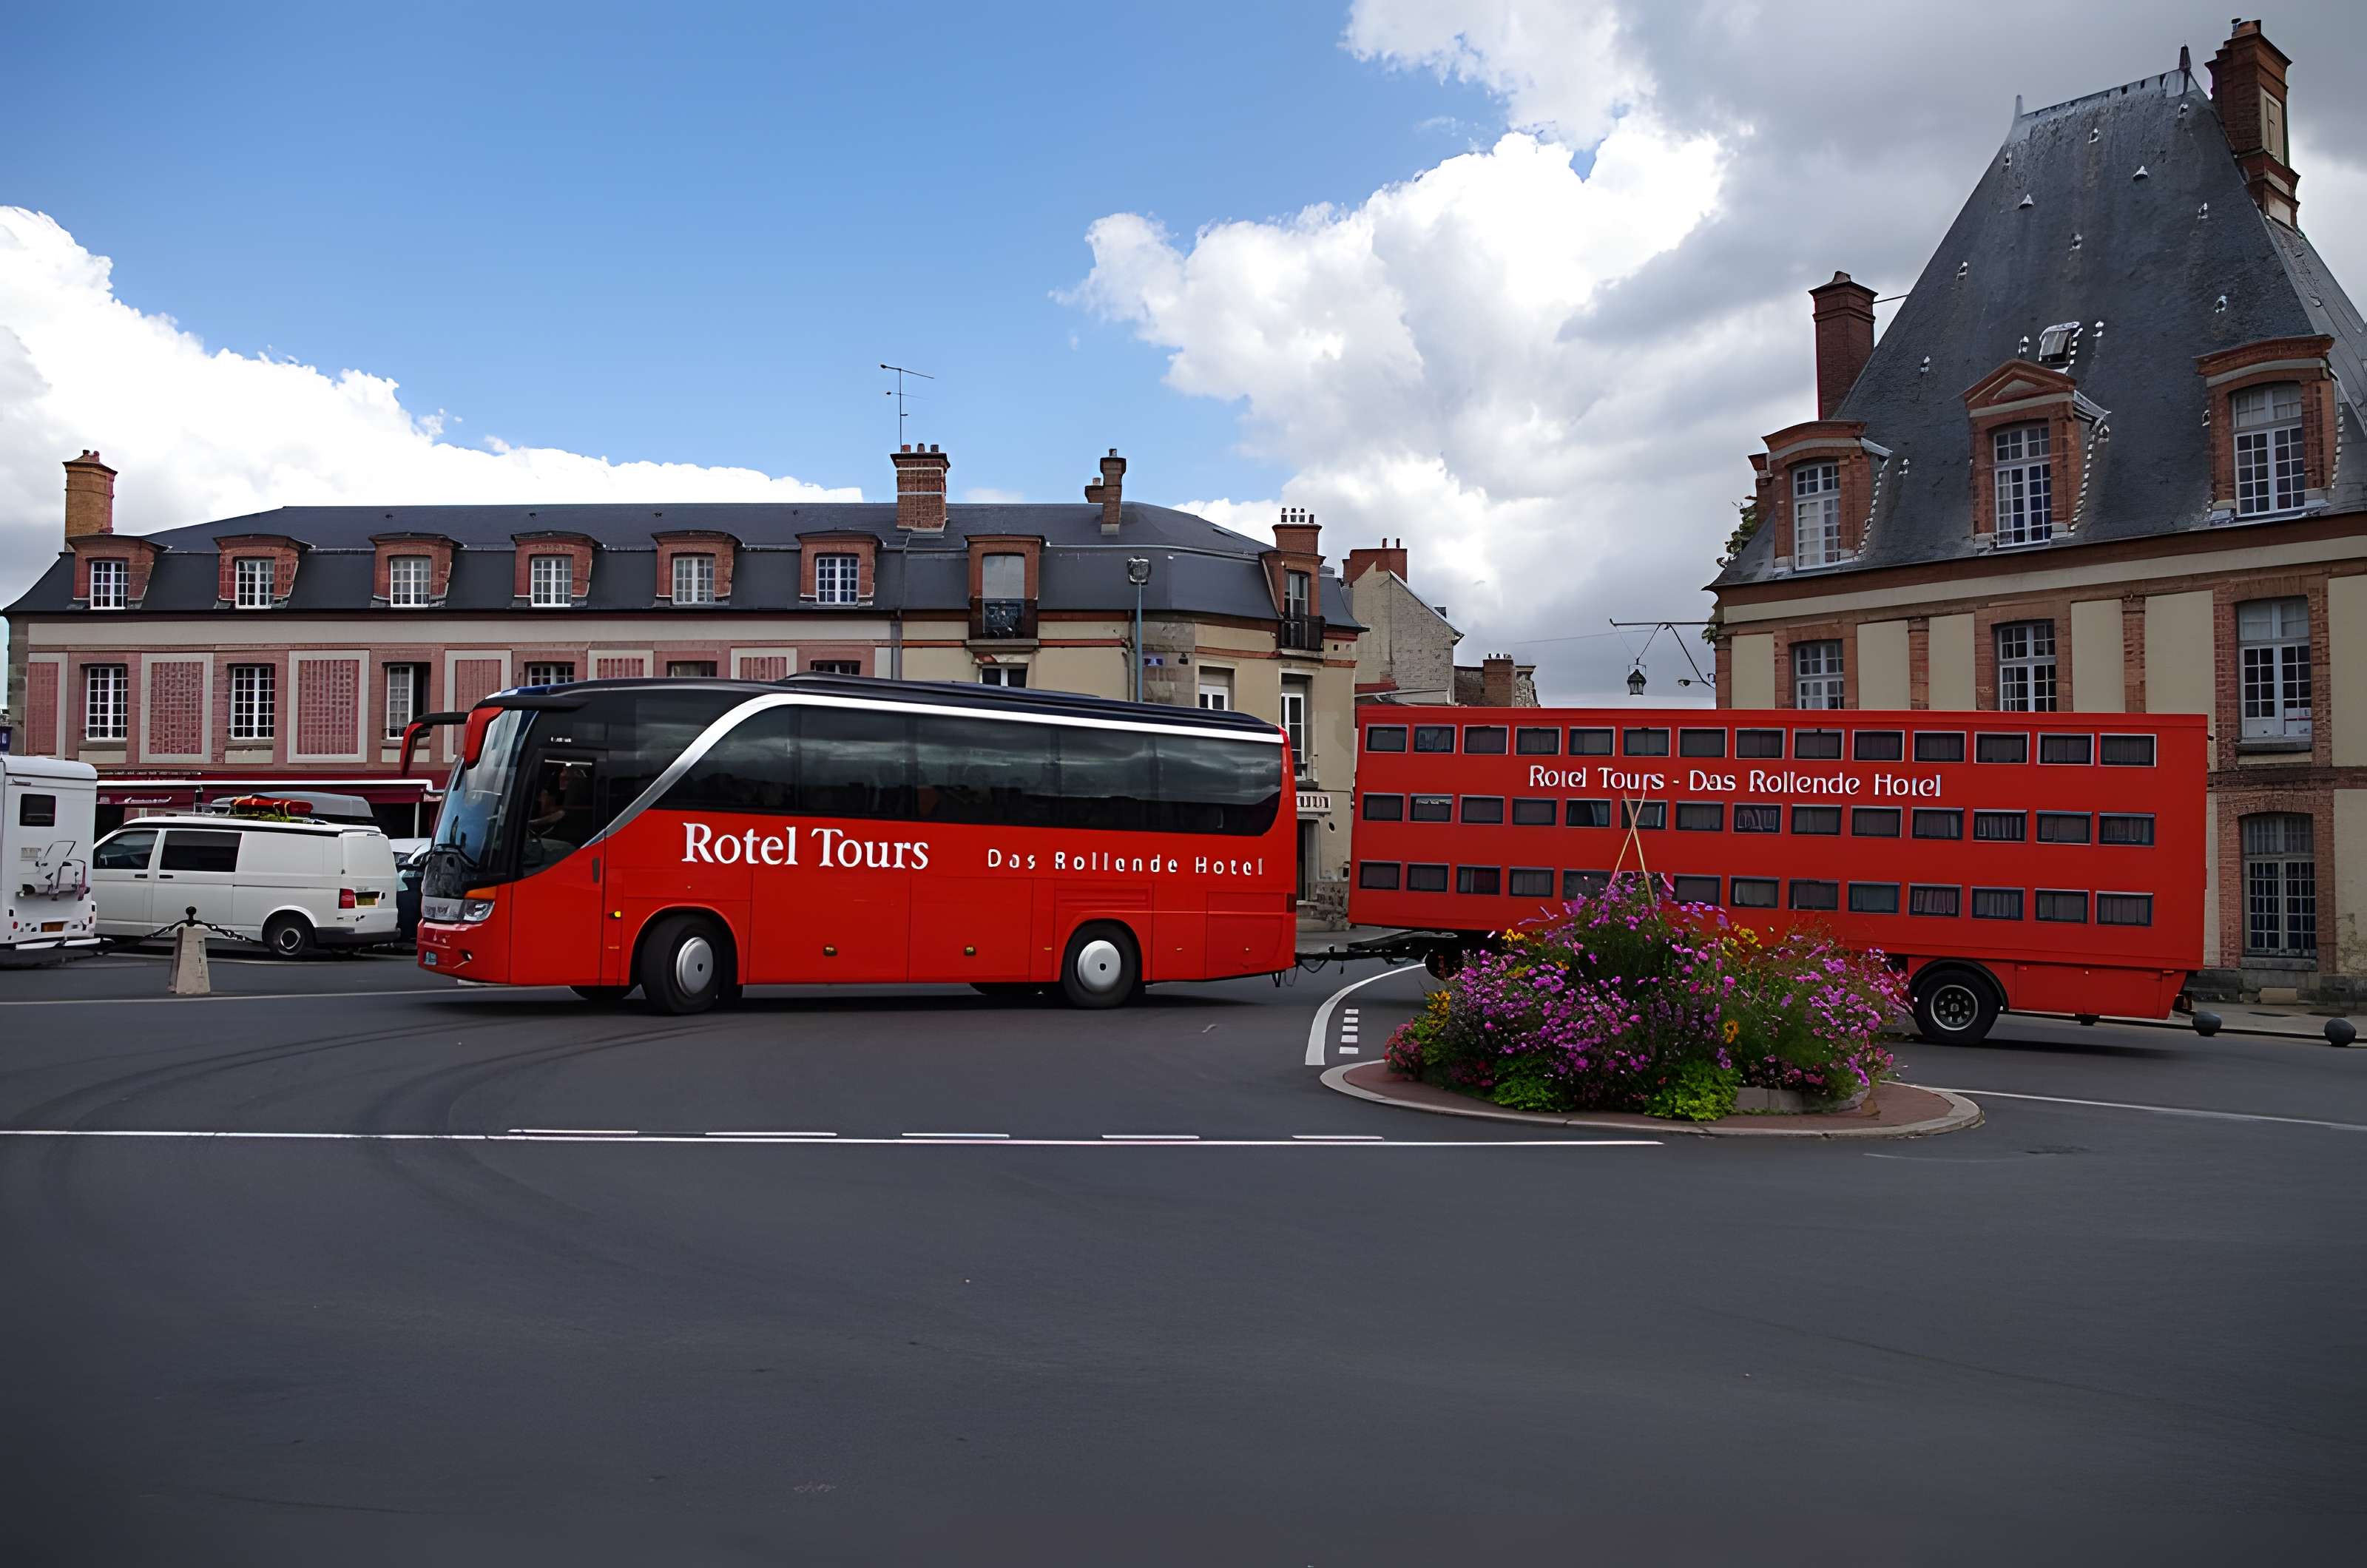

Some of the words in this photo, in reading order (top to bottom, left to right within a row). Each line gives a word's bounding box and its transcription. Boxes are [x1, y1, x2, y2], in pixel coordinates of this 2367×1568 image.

[1529, 765, 1587, 788] Rotel
[1597, 767, 1664, 791] Tours
[1689, 769, 1736, 791] Das
[1749, 769, 1860, 795] Rollende
[1874, 773, 1941, 797] Hotel
[681, 822, 799, 865] Rotel
[811, 828, 929, 870] Tours
[987, 848, 1036, 870] Das
[1055, 851, 1178, 873] Rollende
[1195, 856, 1263, 876] Hotel
